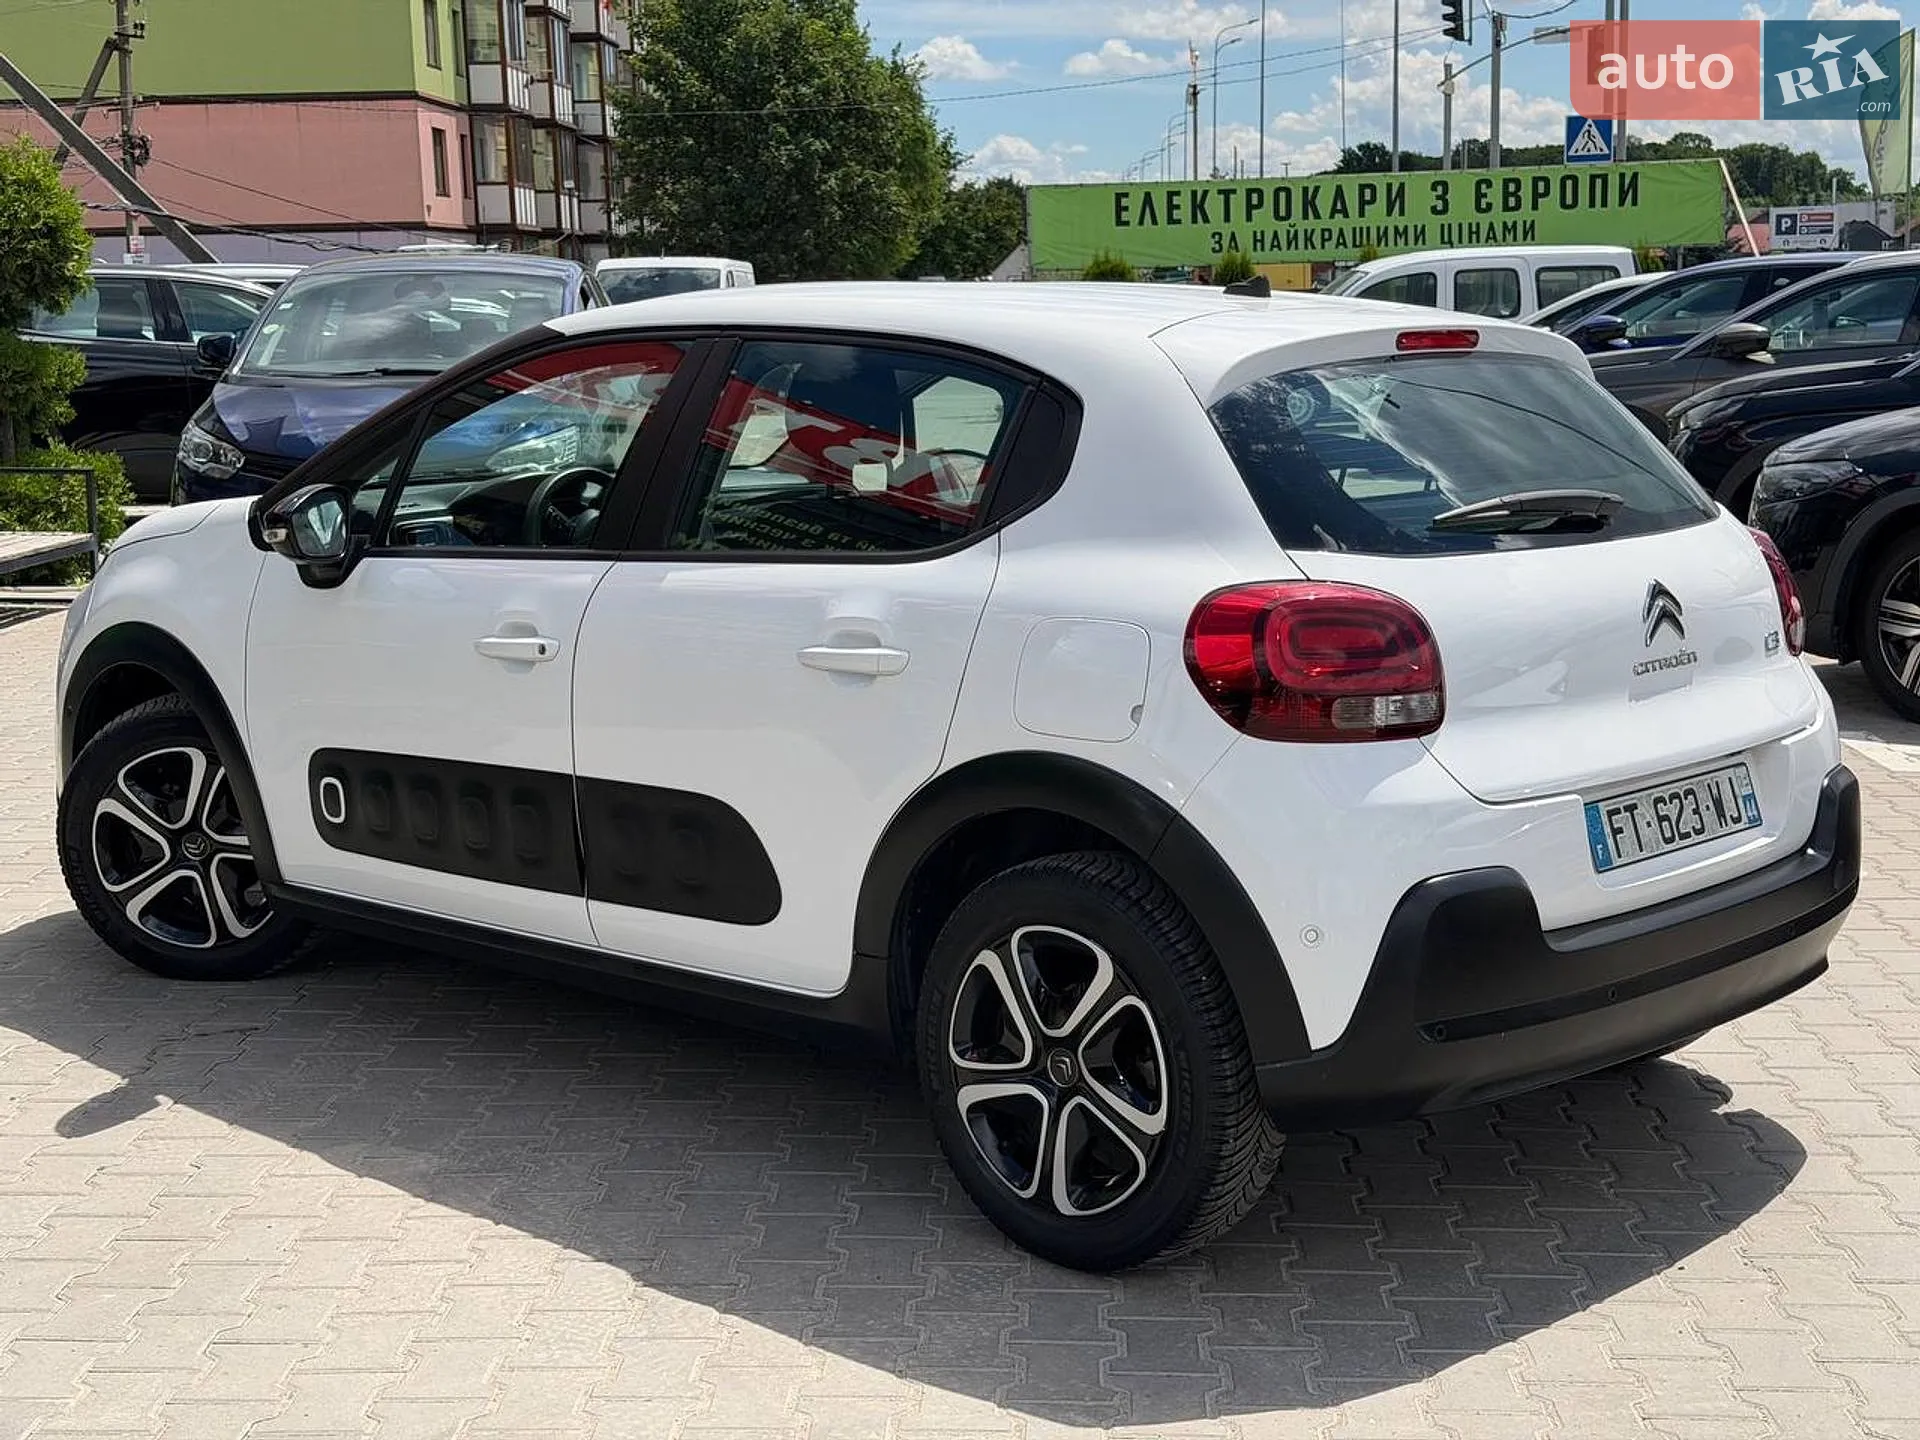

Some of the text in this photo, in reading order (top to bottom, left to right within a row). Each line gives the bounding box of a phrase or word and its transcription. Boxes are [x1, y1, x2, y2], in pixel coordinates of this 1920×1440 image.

[1114, 171, 1640, 227] ЕЛЕКТРОКАРИ З ЄВРОПИ
[1211, 231, 1240, 254] ЗА
[1440, 219, 1536, 246] ЦІНАМИ
[1781, 217, 1791, 232] P
